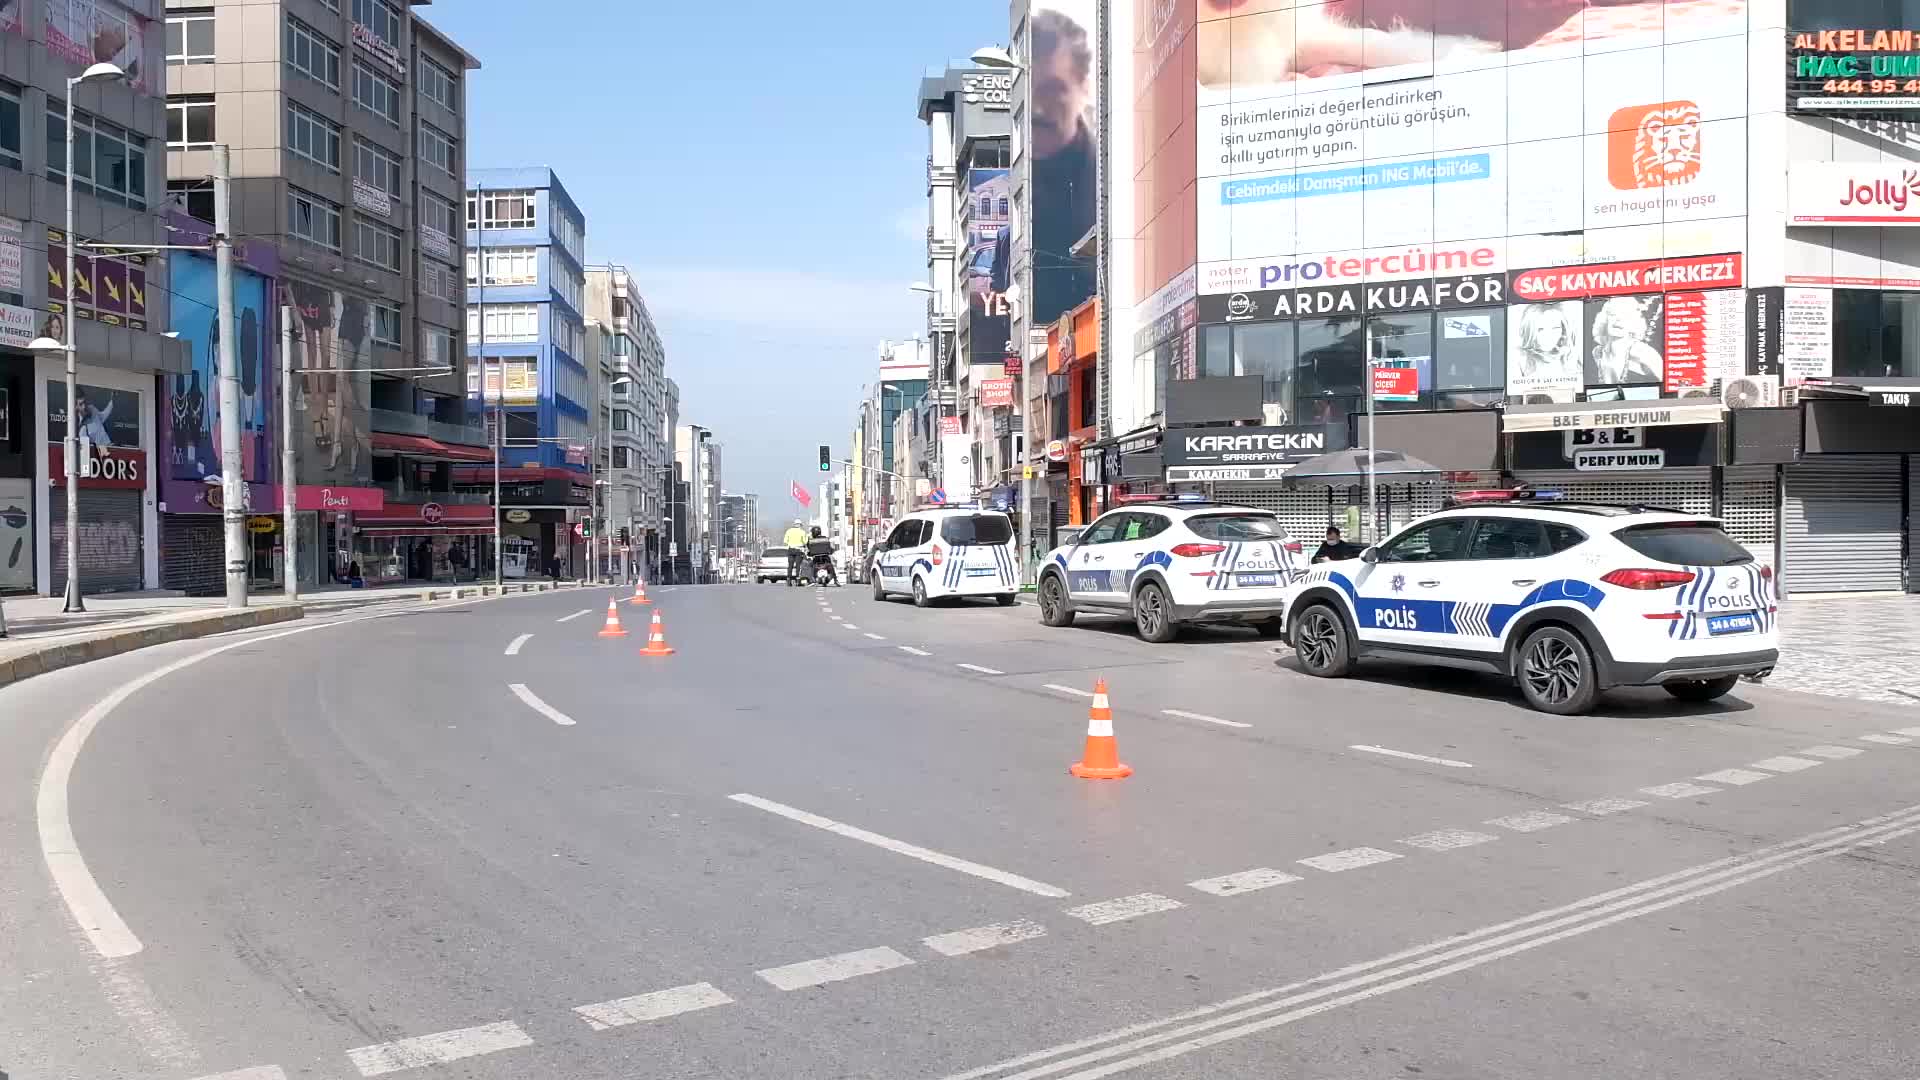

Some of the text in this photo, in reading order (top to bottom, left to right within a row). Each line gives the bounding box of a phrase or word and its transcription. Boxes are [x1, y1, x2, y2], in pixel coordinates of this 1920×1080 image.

[1819, 30, 1912, 51] KELAM
[1796, 56, 1858, 77] HAC
[984, 77, 1011, 89] ENG
[1823, 79, 1864, 93] 444
[1871, 79, 1897, 93] 95
[1221, 89, 1443, 126] Birikimlerinizi değerlendirirken
[1220, 106, 1471, 146] işin uzmanıyla görüntülü görüşün,
[1221, 140, 1357, 164] akıllı yatırım yapın.
[1226, 178, 1301, 199] Cebimdeki
[1304, 173, 1378, 193] Danışman
[1382, 167, 1409, 182] ING
[1594, 193, 1716, 214] sen hayatını yaşa
[1840, 178, 1907, 211] Jolly
[1260, 247, 1494, 288] protercüme
[1520, 257, 1735, 295] SAÇ KAYNAK MERKEZİ
[980, 291, 1011, 317] YE
[1274, 275, 1503, 316] ARDA KUAFÖR
[986, 390, 1010, 398] SHOP
[1553, 411, 1671, 427] B&E PERFUMUM
[91, 457, 138, 480] DORS
[1579, 455, 1660, 467] PERFUMUM
[1238, 560, 1275, 569] POLIS
[1078, 576, 1098, 592] POLİS
[1708, 594, 1752, 608] POLIS
[1375, 605, 1417, 629] POLİS
